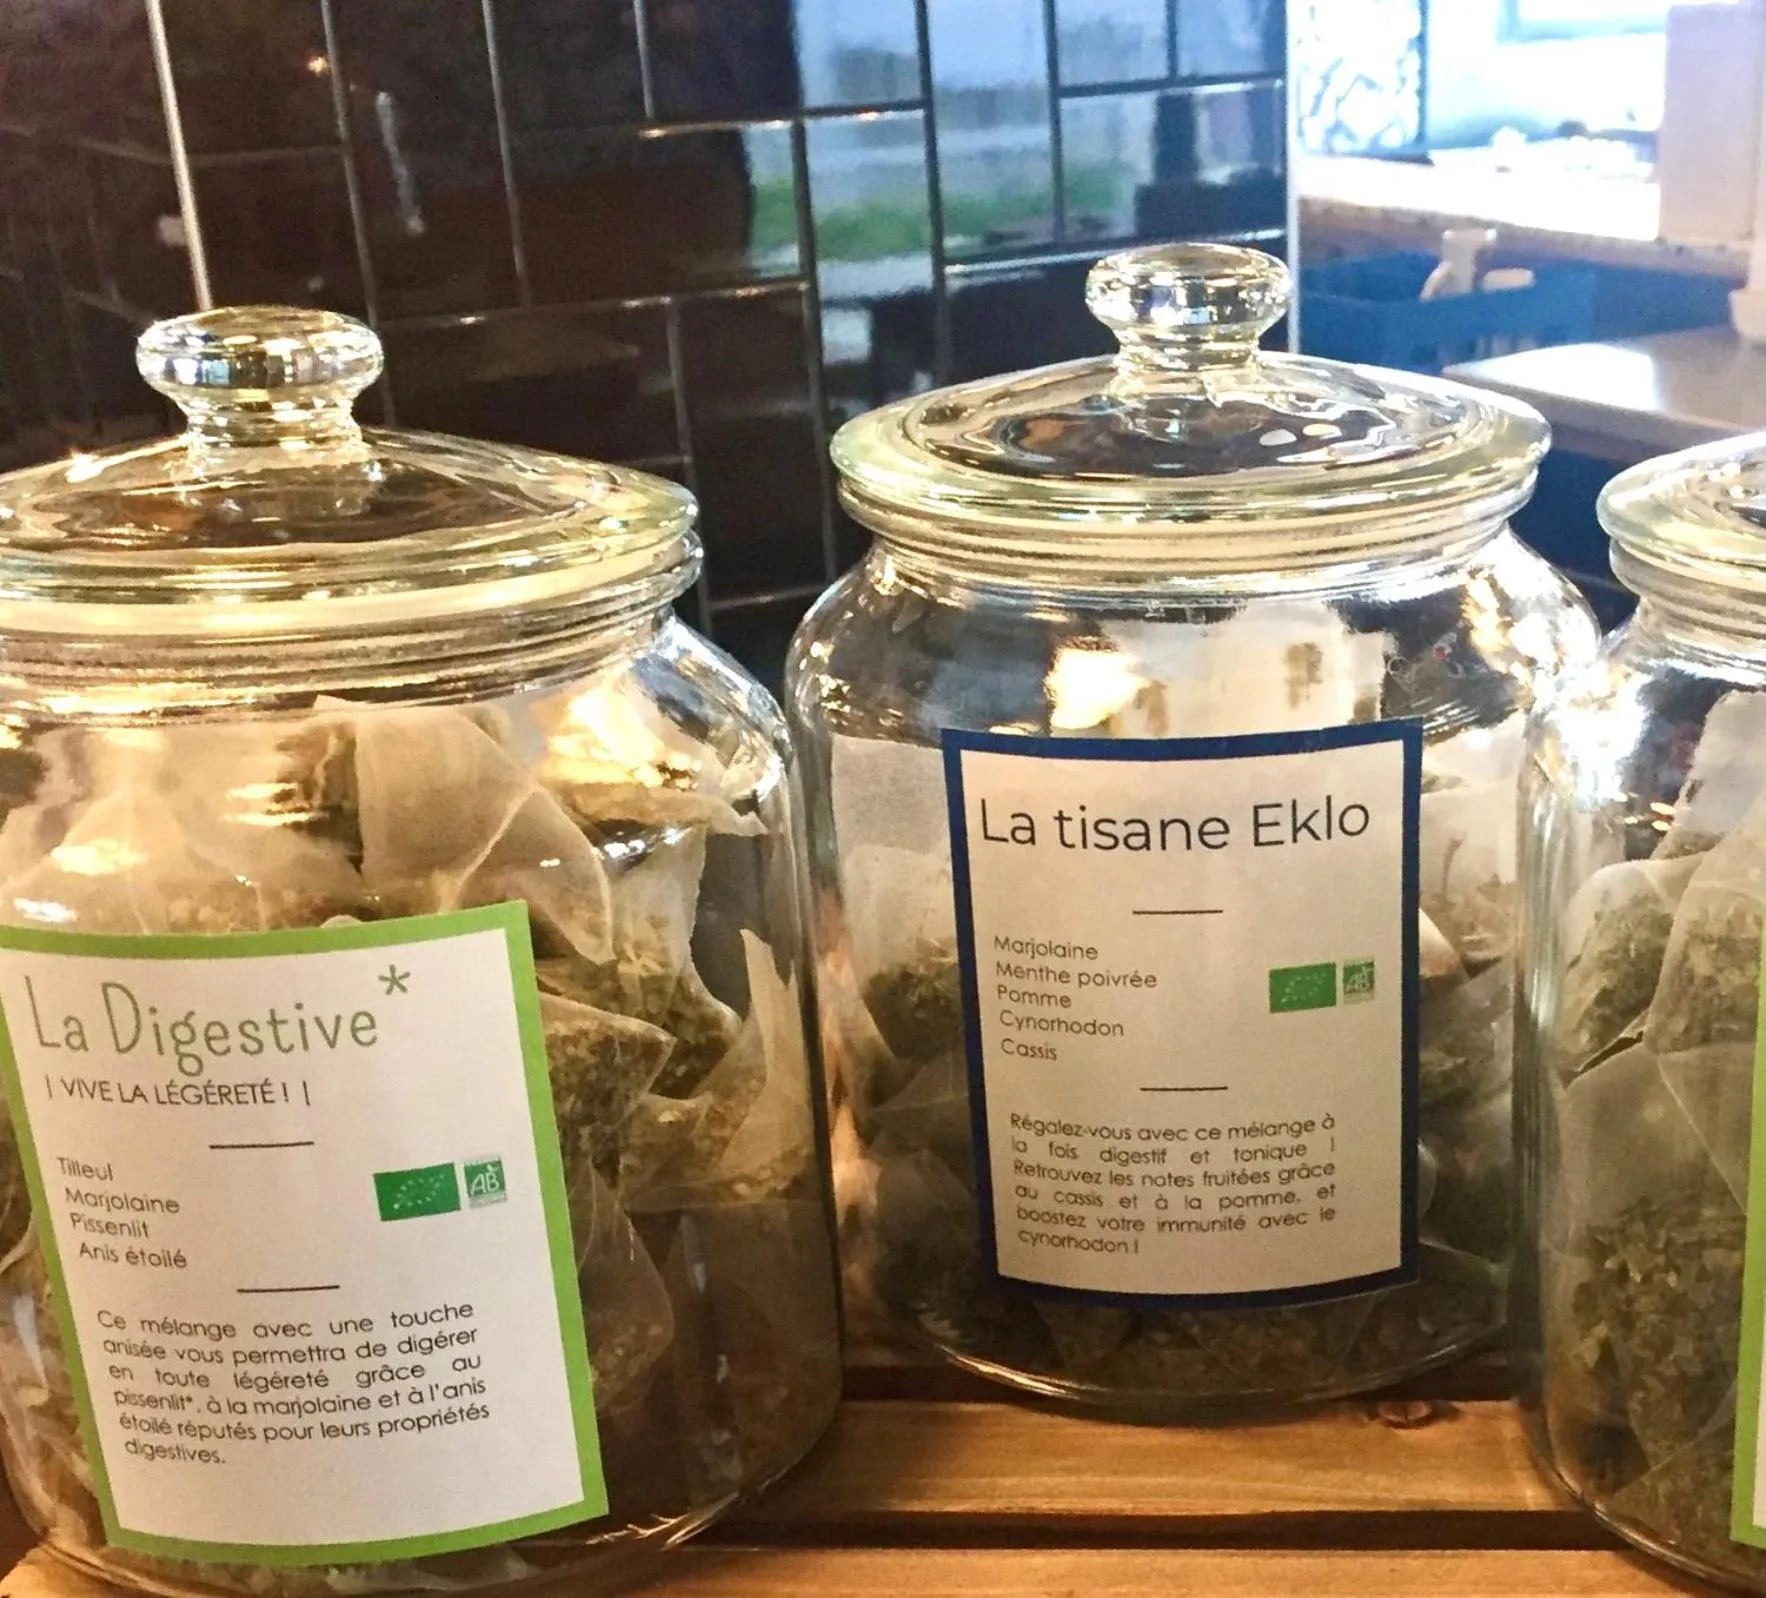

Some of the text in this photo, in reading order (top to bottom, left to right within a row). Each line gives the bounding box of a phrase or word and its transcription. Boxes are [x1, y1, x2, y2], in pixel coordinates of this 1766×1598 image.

[980, 794, 1370, 852] La tisane Eklo
[993, 935, 1099, 961] Marjolaine
[995, 961, 1158, 989] Menthe poivrée
[996, 984, 1072, 1009] Pomme
[24, 974, 90, 1053] La
[999, 1009, 1125, 1037] Cynorhodon
[1000, 1038, 1058, 1062] Cassis
[59, 1077, 114, 1103] VIVE
[117, 1082, 149, 1104] LA
[153, 1077, 276, 1106] LÉGÉRETÉ
[1136, 1127, 1189, 1142] avec
[1194, 1126, 1222, 1141] ce
[1227, 1119, 1317, 1140] mélange
[1321, 1112, 1336, 1130] à
[1011, 1135, 1028, 1154] la
[1048, 1140, 1079, 1161] fois
[1099, 1146, 1168, 1168] digestif
[1189, 1149, 1211, 1165] et
[1233, 1143, 1308, 1163] tonique
[55, 1156, 114, 1182] Tilleul
[1013, 1158, 1336, 1189] Retrouvez les notes fruitées grâce
[64, 1186, 180, 1216] Marjolaine
[1014, 1184, 1039, 1200] au
[1052, 1189, 1104, 1208] cassis
[1118, 1194, 1138, 1210] et
[1154, 1193, 1169, 1211] à
[1184, 1195, 1202, 1211] la
[1316, 1183, 1337, 1200] et
[69, 1210, 150, 1239] Pissenlit
[1016, 1202, 1337, 1233] boostez votre immunité avec le
[79, 1241, 188, 1270] Anis étoilé
[96, 1303, 474, 1341] Ce mélange avec une touche
[102, 1328, 478, 1369] anisée vous permettra de digérer
[108, 1364, 134, 1381] en
[154, 1367, 211, 1389] toute
[355, 1363, 426, 1390] grâce
[451, 1355, 481, 1373] au
[206, 1395, 223, 1415] à
[226, 1397, 249, 1415] la
[252, 1390, 372, 1419] marjolaine
[377, 1389, 401, 1409] et
[407, 1386, 425, 1405] à
[119, 1400, 490, 1444] étoilé réputés pour leurs propriétés
[124, 1437, 226, 1465] digestives.
